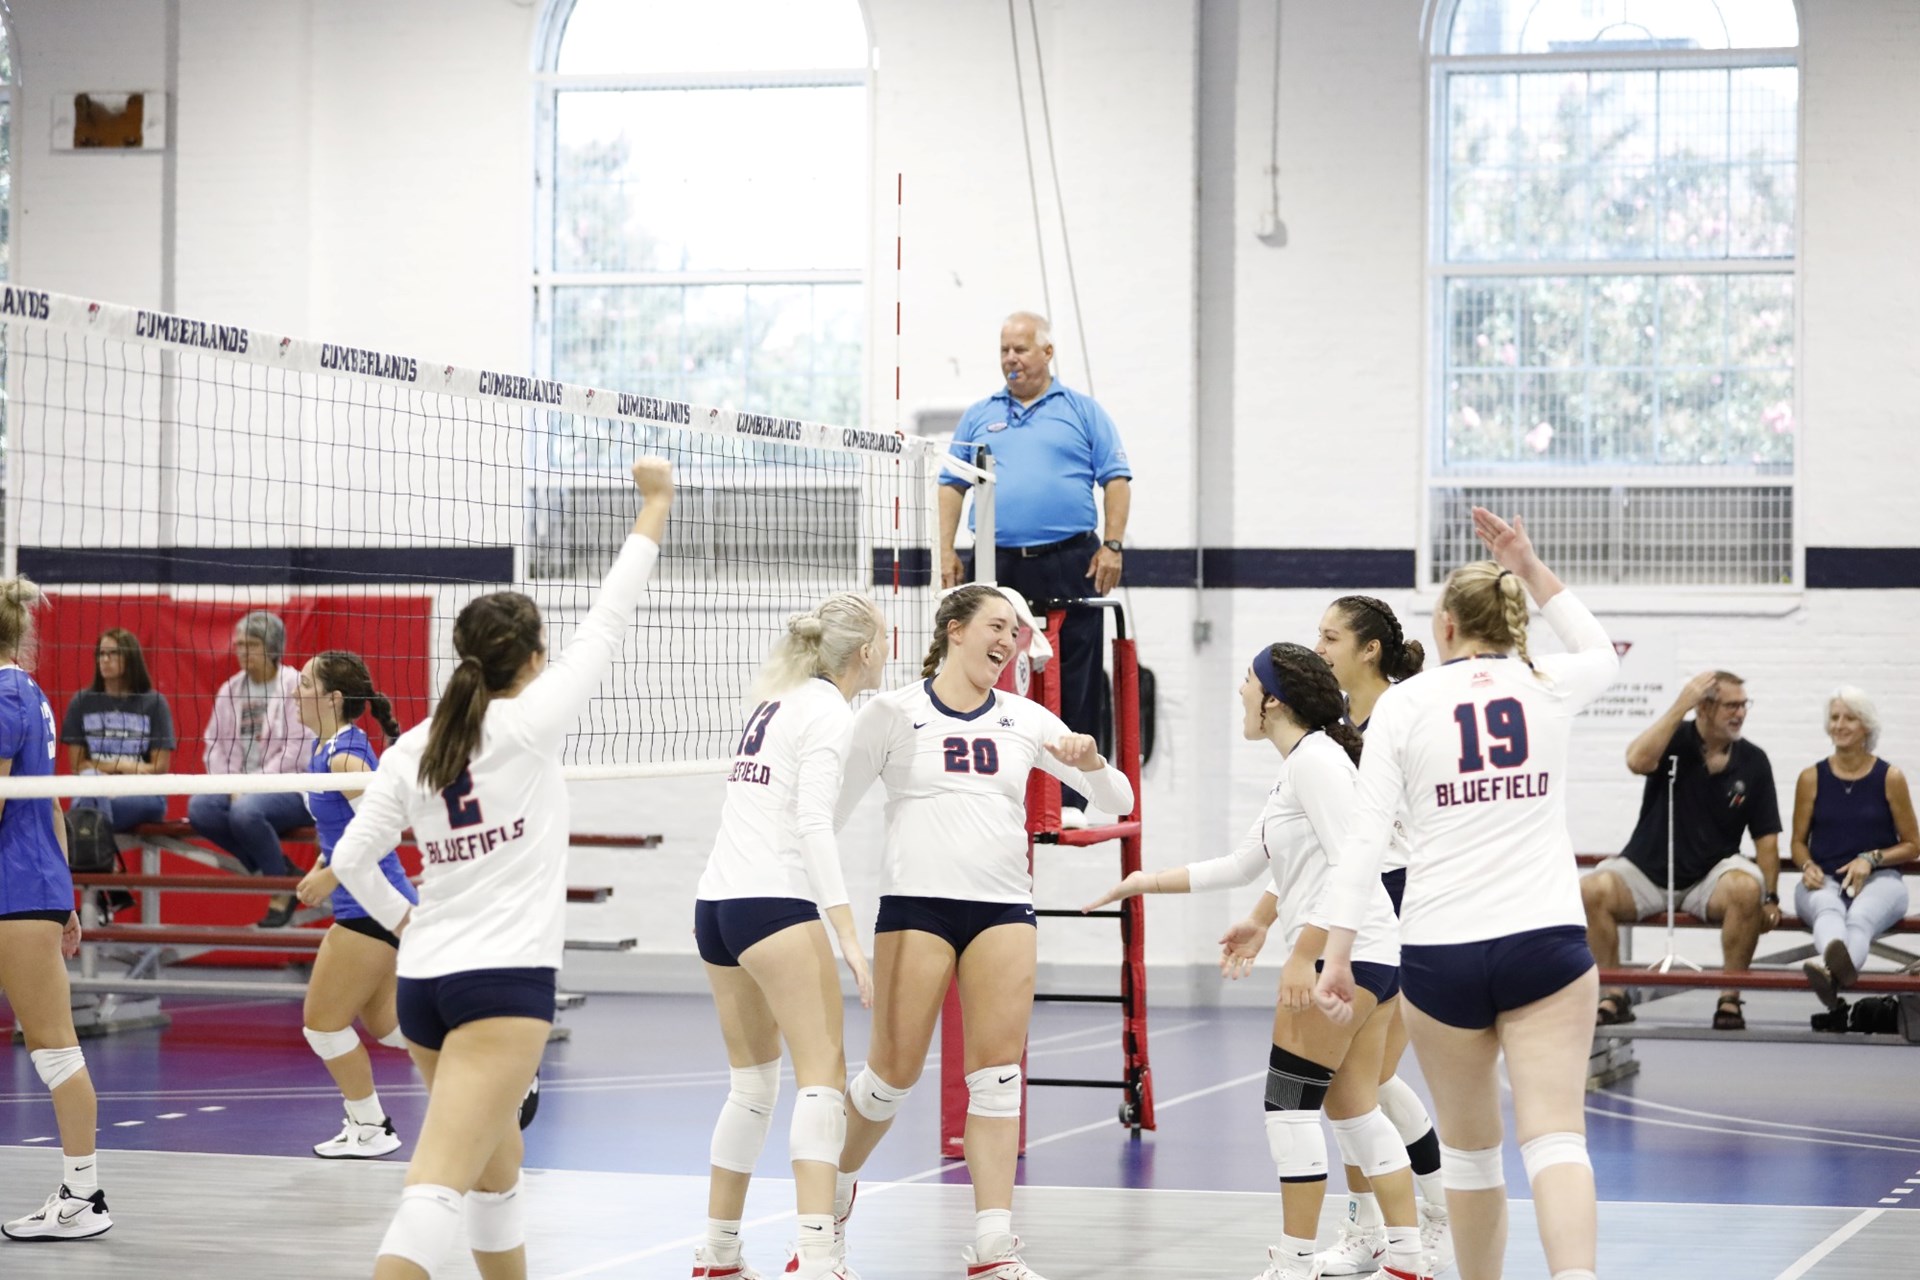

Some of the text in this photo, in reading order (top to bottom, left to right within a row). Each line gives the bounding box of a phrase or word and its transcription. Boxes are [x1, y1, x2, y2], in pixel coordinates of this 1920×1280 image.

[0, 287, 50, 320] ANDS
[136, 311, 249, 354] CUMBERLANDS
[320, 343, 418, 382] CUMBERLANDS
[479, 371, 563, 406] CUMBERLANDS
[617, 393, 691, 425] CUMBERLANDS
[1643, 683, 1663, 692] FOR
[736, 700, 781, 757] 13
[1453, 697, 1529, 774] 19
[943, 737, 999, 775] 20
[441, 757, 483, 830] 2
[1435, 772, 1549, 807] BLUEFIELD
